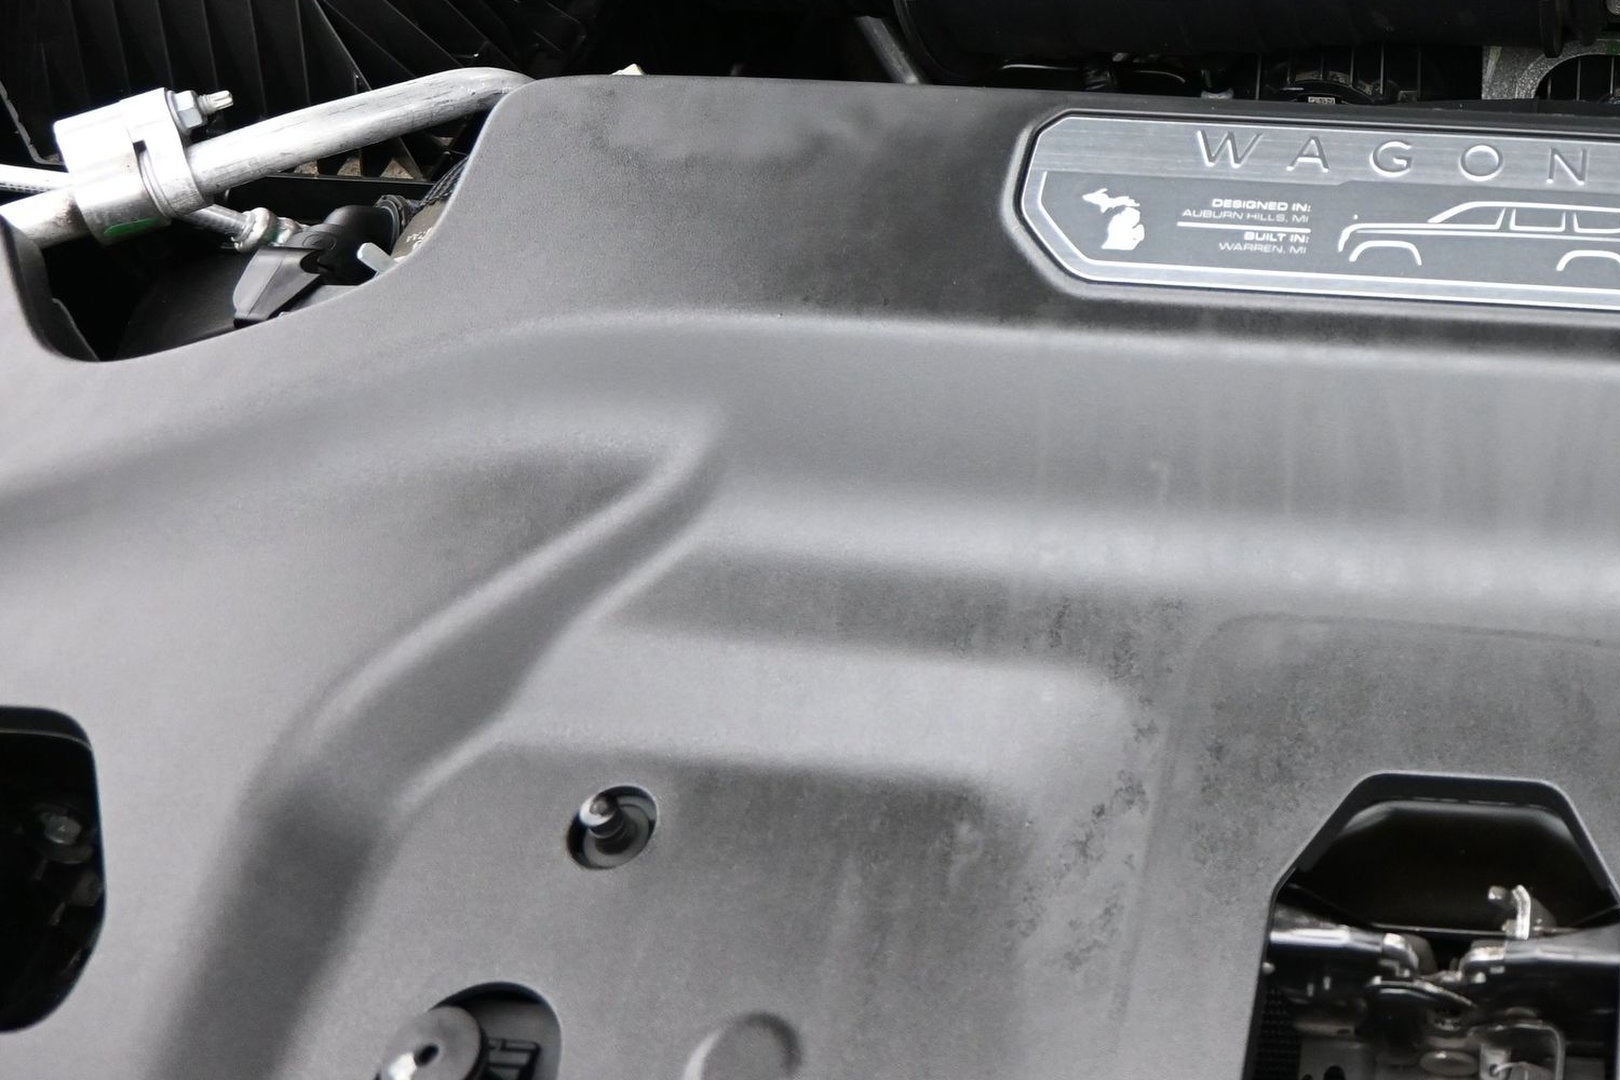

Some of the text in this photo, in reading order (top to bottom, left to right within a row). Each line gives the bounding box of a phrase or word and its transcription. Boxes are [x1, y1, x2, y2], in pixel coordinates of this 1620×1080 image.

[1212, 198, 1312, 213] DESIGNED IN:
[1182, 208, 1244, 220] AUBURN
[1292, 214, 1309, 223] MI
[1244, 231, 1310, 244] BUILT IN:
[1218, 242, 1307, 254] WARREN, MI
